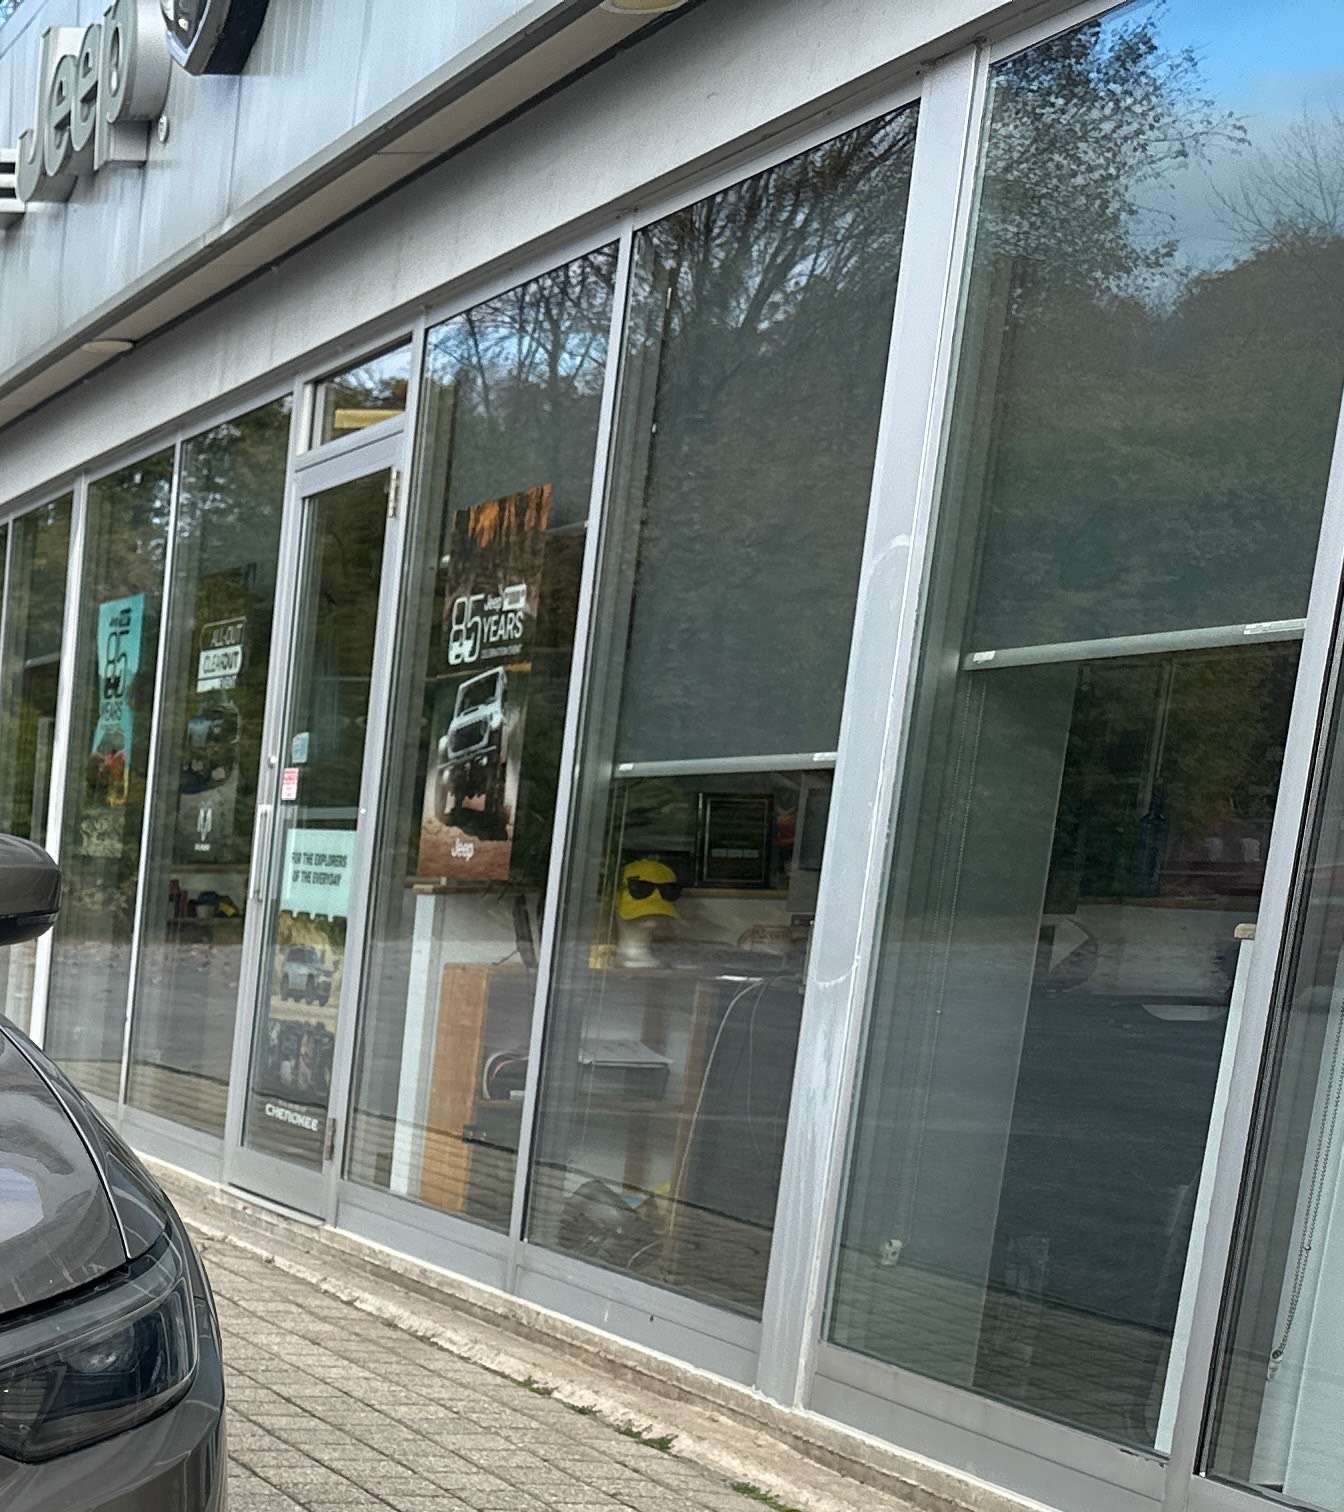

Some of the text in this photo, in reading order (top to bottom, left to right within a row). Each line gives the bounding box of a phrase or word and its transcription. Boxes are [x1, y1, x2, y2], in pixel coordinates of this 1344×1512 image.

[15, 0, 150, 200] Jeep
[448, 593, 485, 665] 85
[482, 611, 524, 643] YEARS
[450, 837, 475, 862] Jeep
[265, 1103, 319, 1132] CHEROKEE
